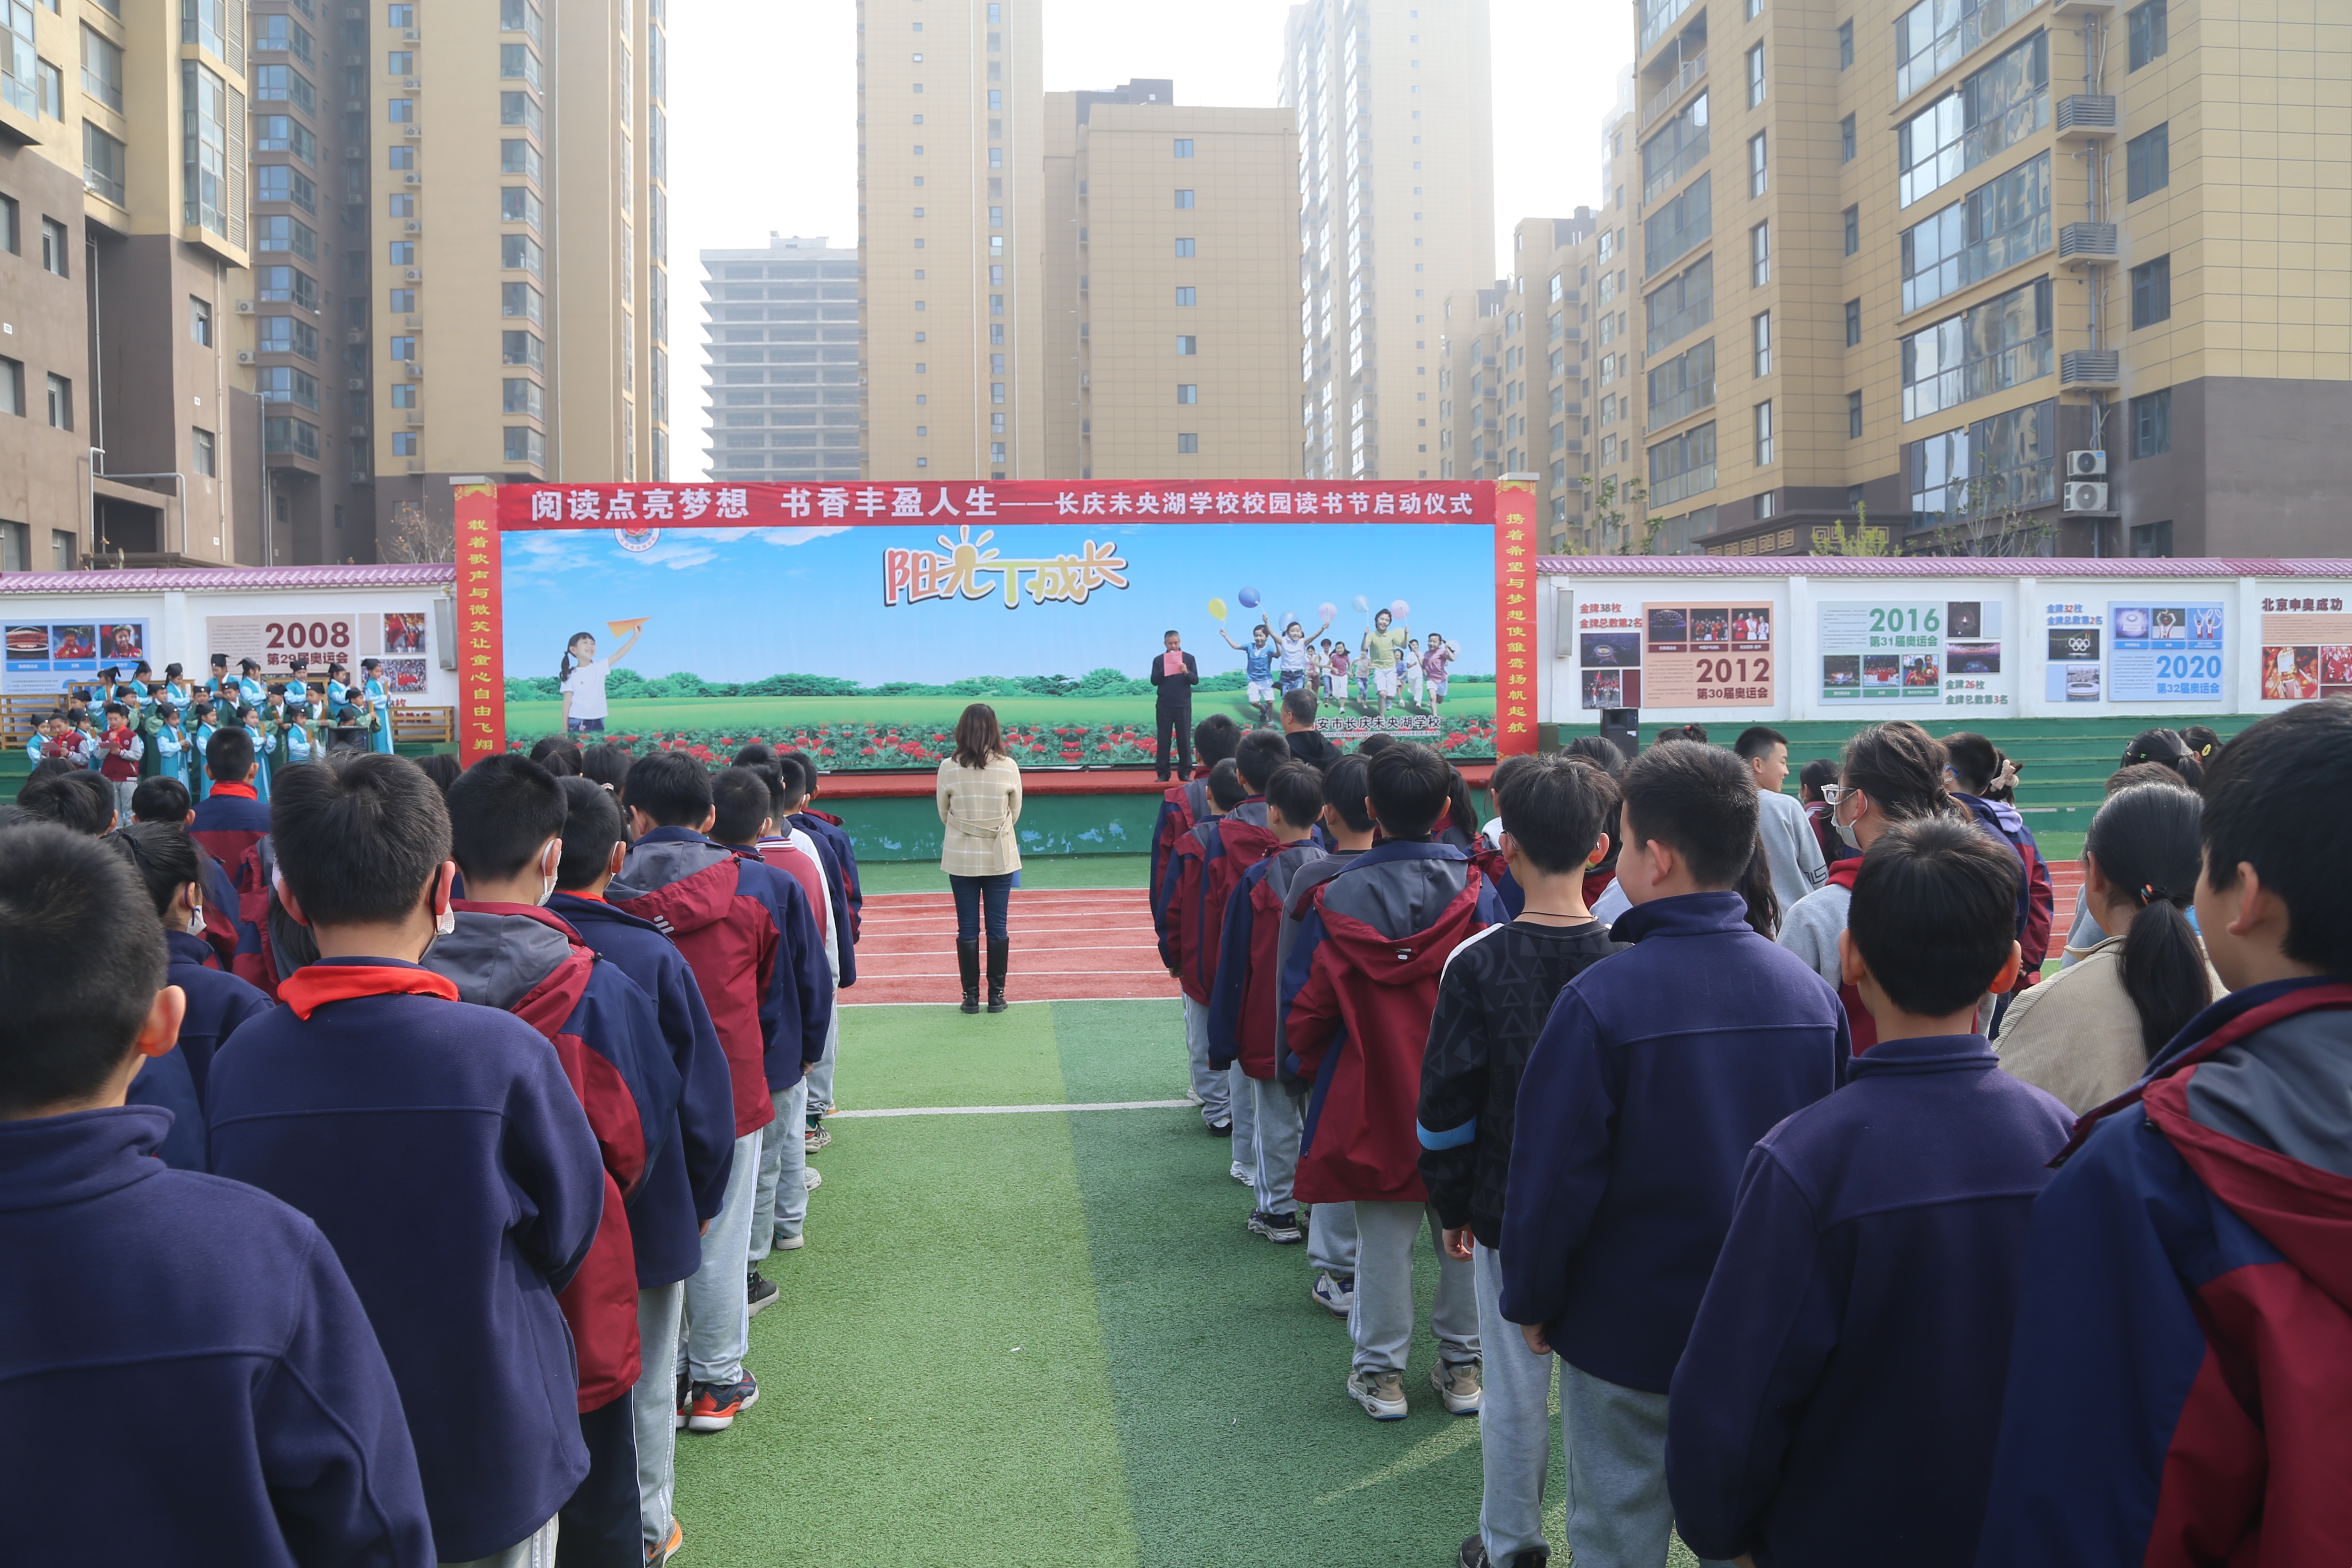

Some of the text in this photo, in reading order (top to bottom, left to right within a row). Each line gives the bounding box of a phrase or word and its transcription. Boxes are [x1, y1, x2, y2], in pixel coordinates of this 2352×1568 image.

[531, 488, 749, 521] 阅读点亮梦想
[885, 525, 1127, 609] 阳光下成长
[1580, 603, 1622, 614] 金牌38枚
[2047, 603, 2083, 613] 金牌32枚
[2262, 598, 2343, 612] 北京申奥成功
[1505, 513, 1527, 733] 携着希望与梦想使雏鹰扬帆起航
[1580, 618, 1643, 629] 金牌总数第2名
[1869, 608, 1940, 632] 2016
[265, 622, 350, 649] 2008
[467, 519, 493, 750] 载着歌声与微笑让童心自由飞翔
[1870, 635, 1938, 647] 第31届奥运会
[267, 652, 348, 666] 第29届奥运会
[1696, 658, 1770, 683] 2012
[2156, 655, 2221, 679] 2020
[1945, 679, 1985, 690] 金牌26枚
[2157, 683, 2220, 694] 第32届奥运会
[1697, 687, 1768, 700] 第30届奥运会
[1945, 694, 2009, 705] 金牌总数第3名
[1312, 715, 1441, 730] 安市长庆未央湖学校
